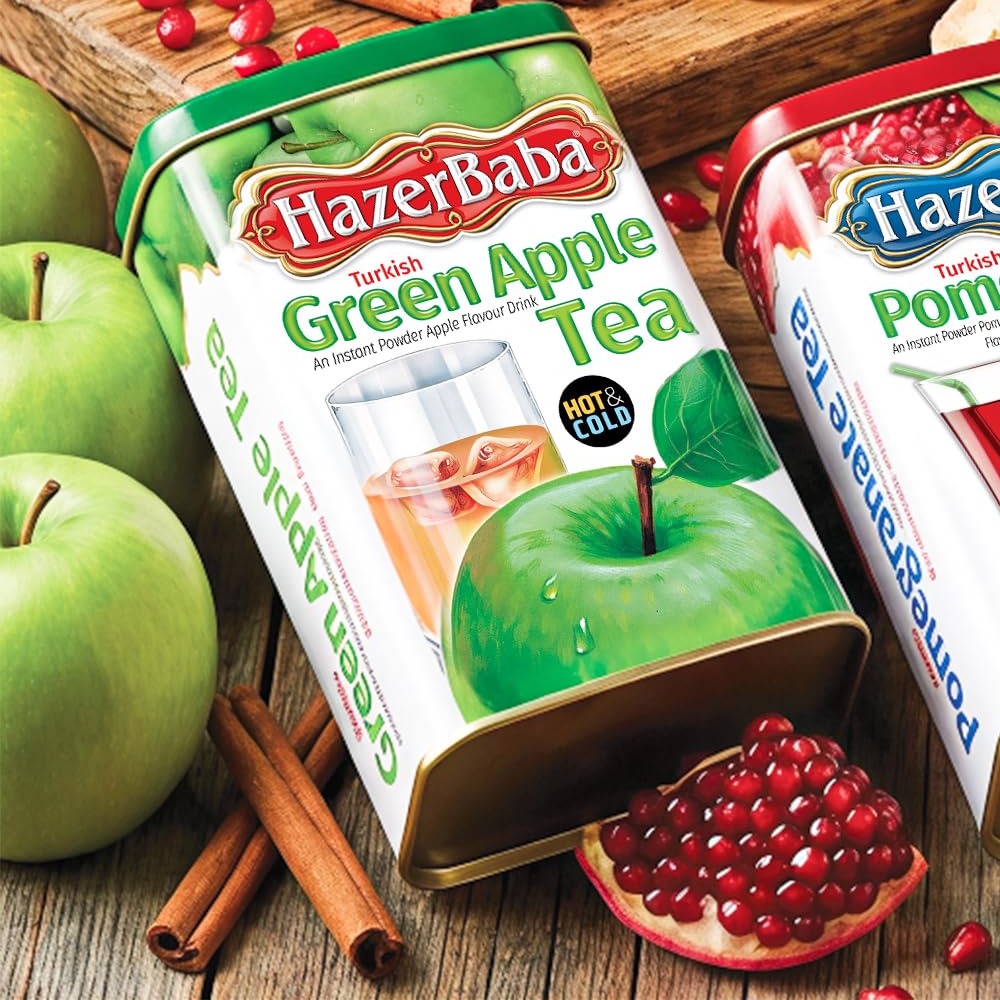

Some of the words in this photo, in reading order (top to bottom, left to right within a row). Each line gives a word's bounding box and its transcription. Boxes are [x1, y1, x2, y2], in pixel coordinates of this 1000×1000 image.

[272, 134, 597, 250] HazerBaba
[282, 265, 481, 353] Green
[487, 213, 657, 300] Apple
[349, 256, 423, 289] Turkish
[534, 287, 699, 367] Tea
[205, 317, 248, 441] Tea
[313, 355, 330, 371] An
[332, 343, 377, 367] Instant
[378, 331, 423, 355] Powder
[426, 317, 460, 340] Apple
[462, 305, 505, 328] Flavour
[507, 294, 540, 319] Drink
[790, 296, 829, 411] Tea
[892, 341, 905, 355] An
[906, 333, 940, 352] Instant
[942, 323, 976, 343] Powder
[572, 406, 633, 440] COLD
[251, 434, 329, 605] Apple
[828, 391, 980, 755] Pomegranate
[322, 601, 398, 786] Green
